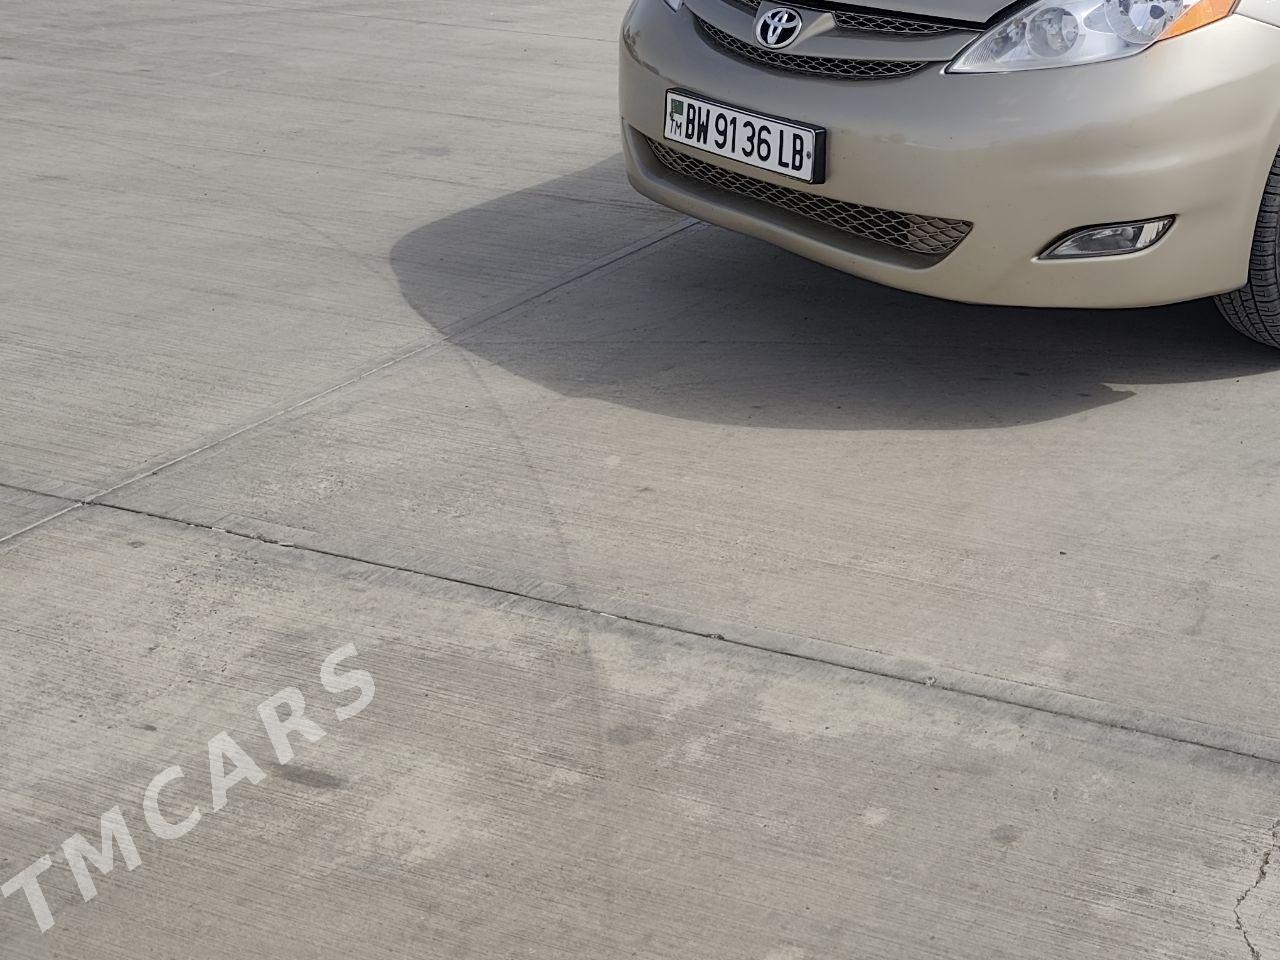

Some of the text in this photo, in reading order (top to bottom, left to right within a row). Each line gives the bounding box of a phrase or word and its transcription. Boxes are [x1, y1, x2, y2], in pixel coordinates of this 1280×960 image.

[669, 118, 682, 137] TM
[685, 102, 804, 172] BW 9136 LB
